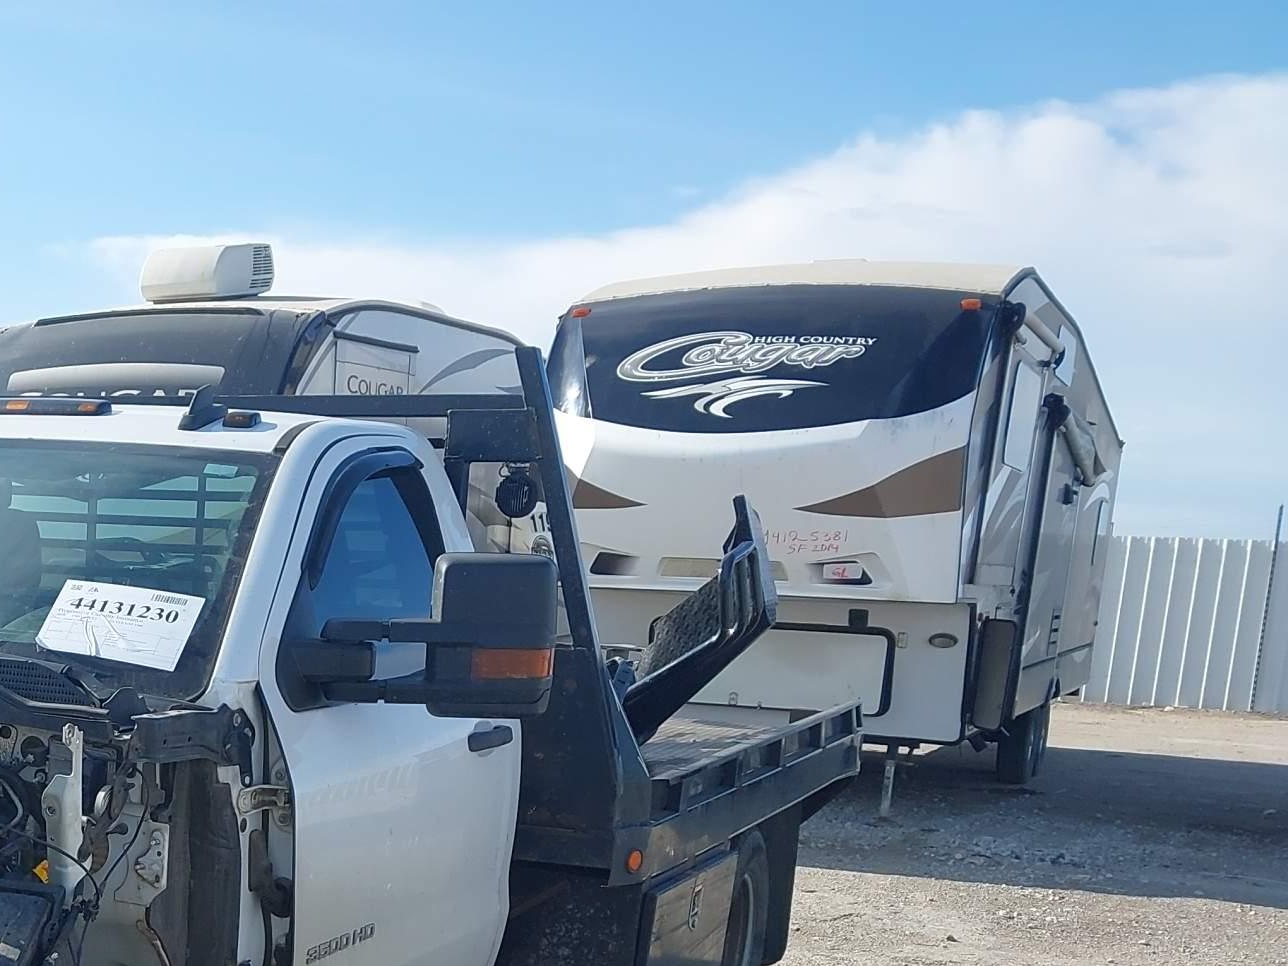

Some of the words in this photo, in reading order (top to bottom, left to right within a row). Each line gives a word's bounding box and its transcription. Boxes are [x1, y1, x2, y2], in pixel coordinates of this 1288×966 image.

[754, 336, 798, 344] HIGH
[803, 336, 877, 346] COUNTRY
[617, 331, 865, 381] Cougar
[70, 597, 179, 624] 44131230
